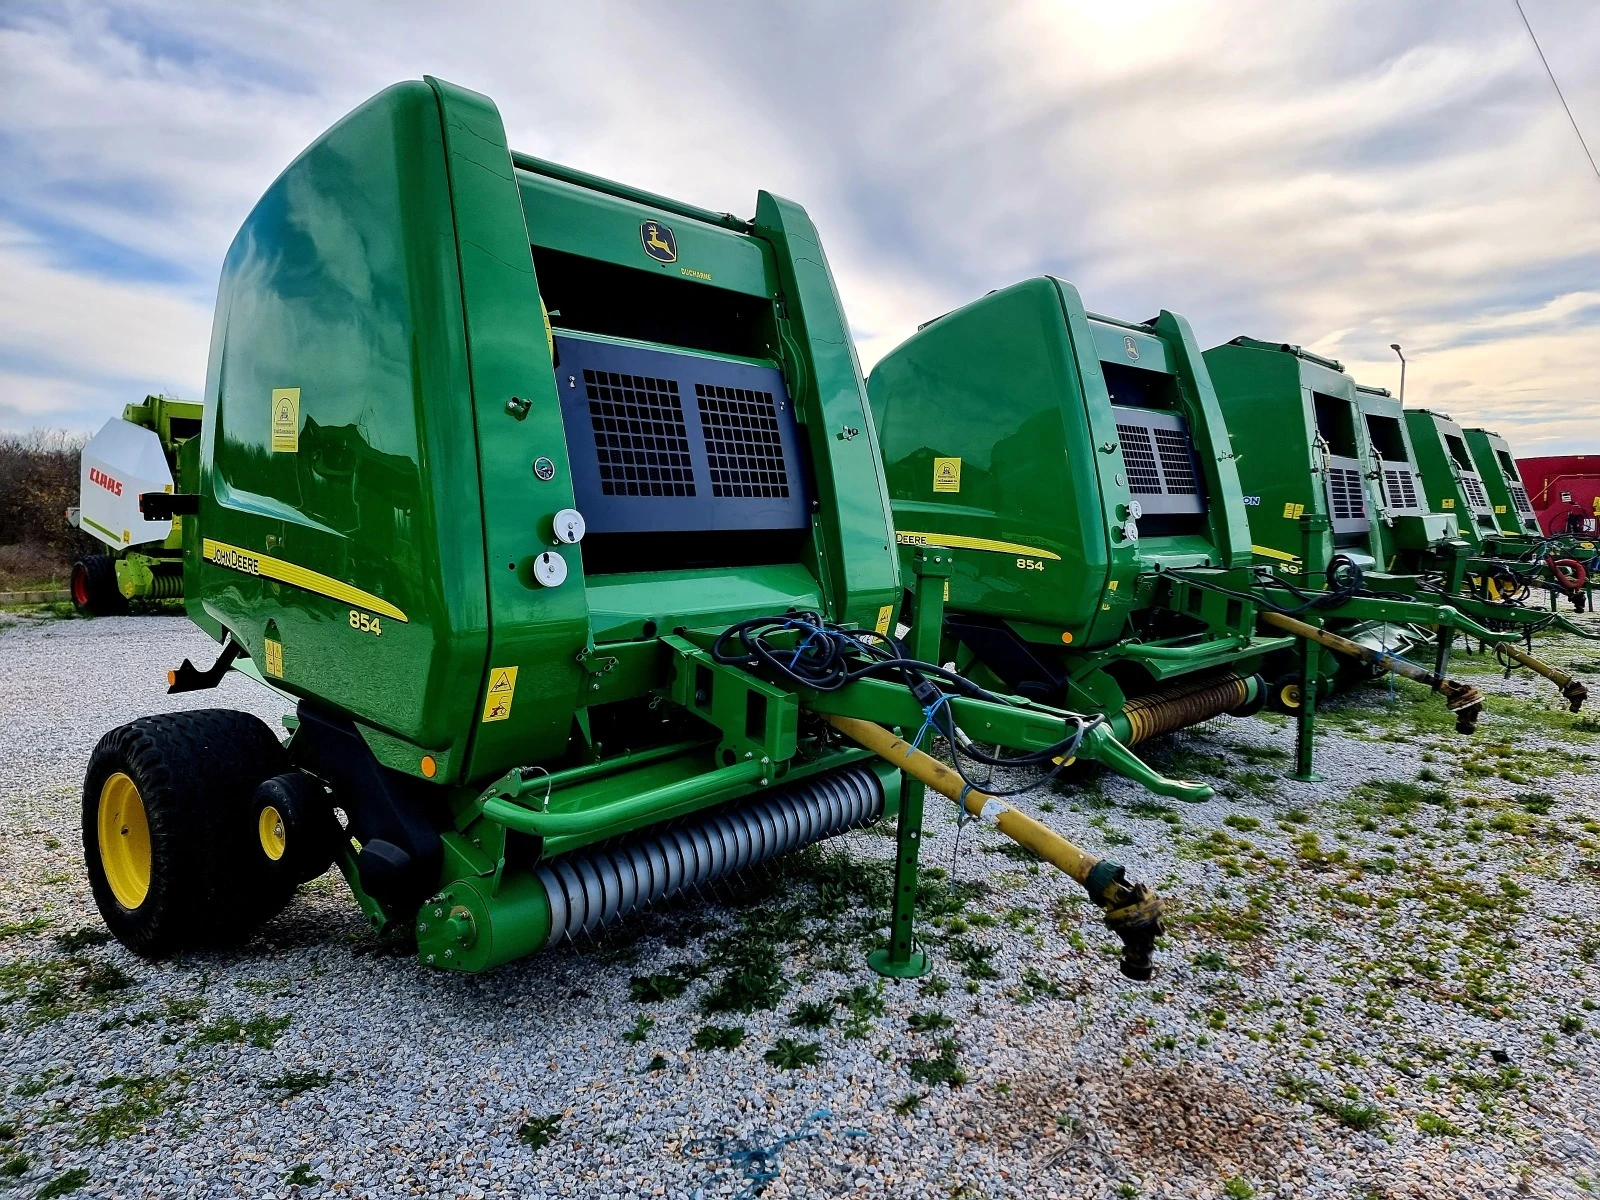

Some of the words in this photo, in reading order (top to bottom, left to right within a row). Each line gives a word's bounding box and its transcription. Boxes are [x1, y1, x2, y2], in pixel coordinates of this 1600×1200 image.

[89, 467, 123, 497] CLAAS
[896, 533, 927, 546] DEERE
[1016, 558, 1045, 572] 854
[349, 609, 382, 636] 854
